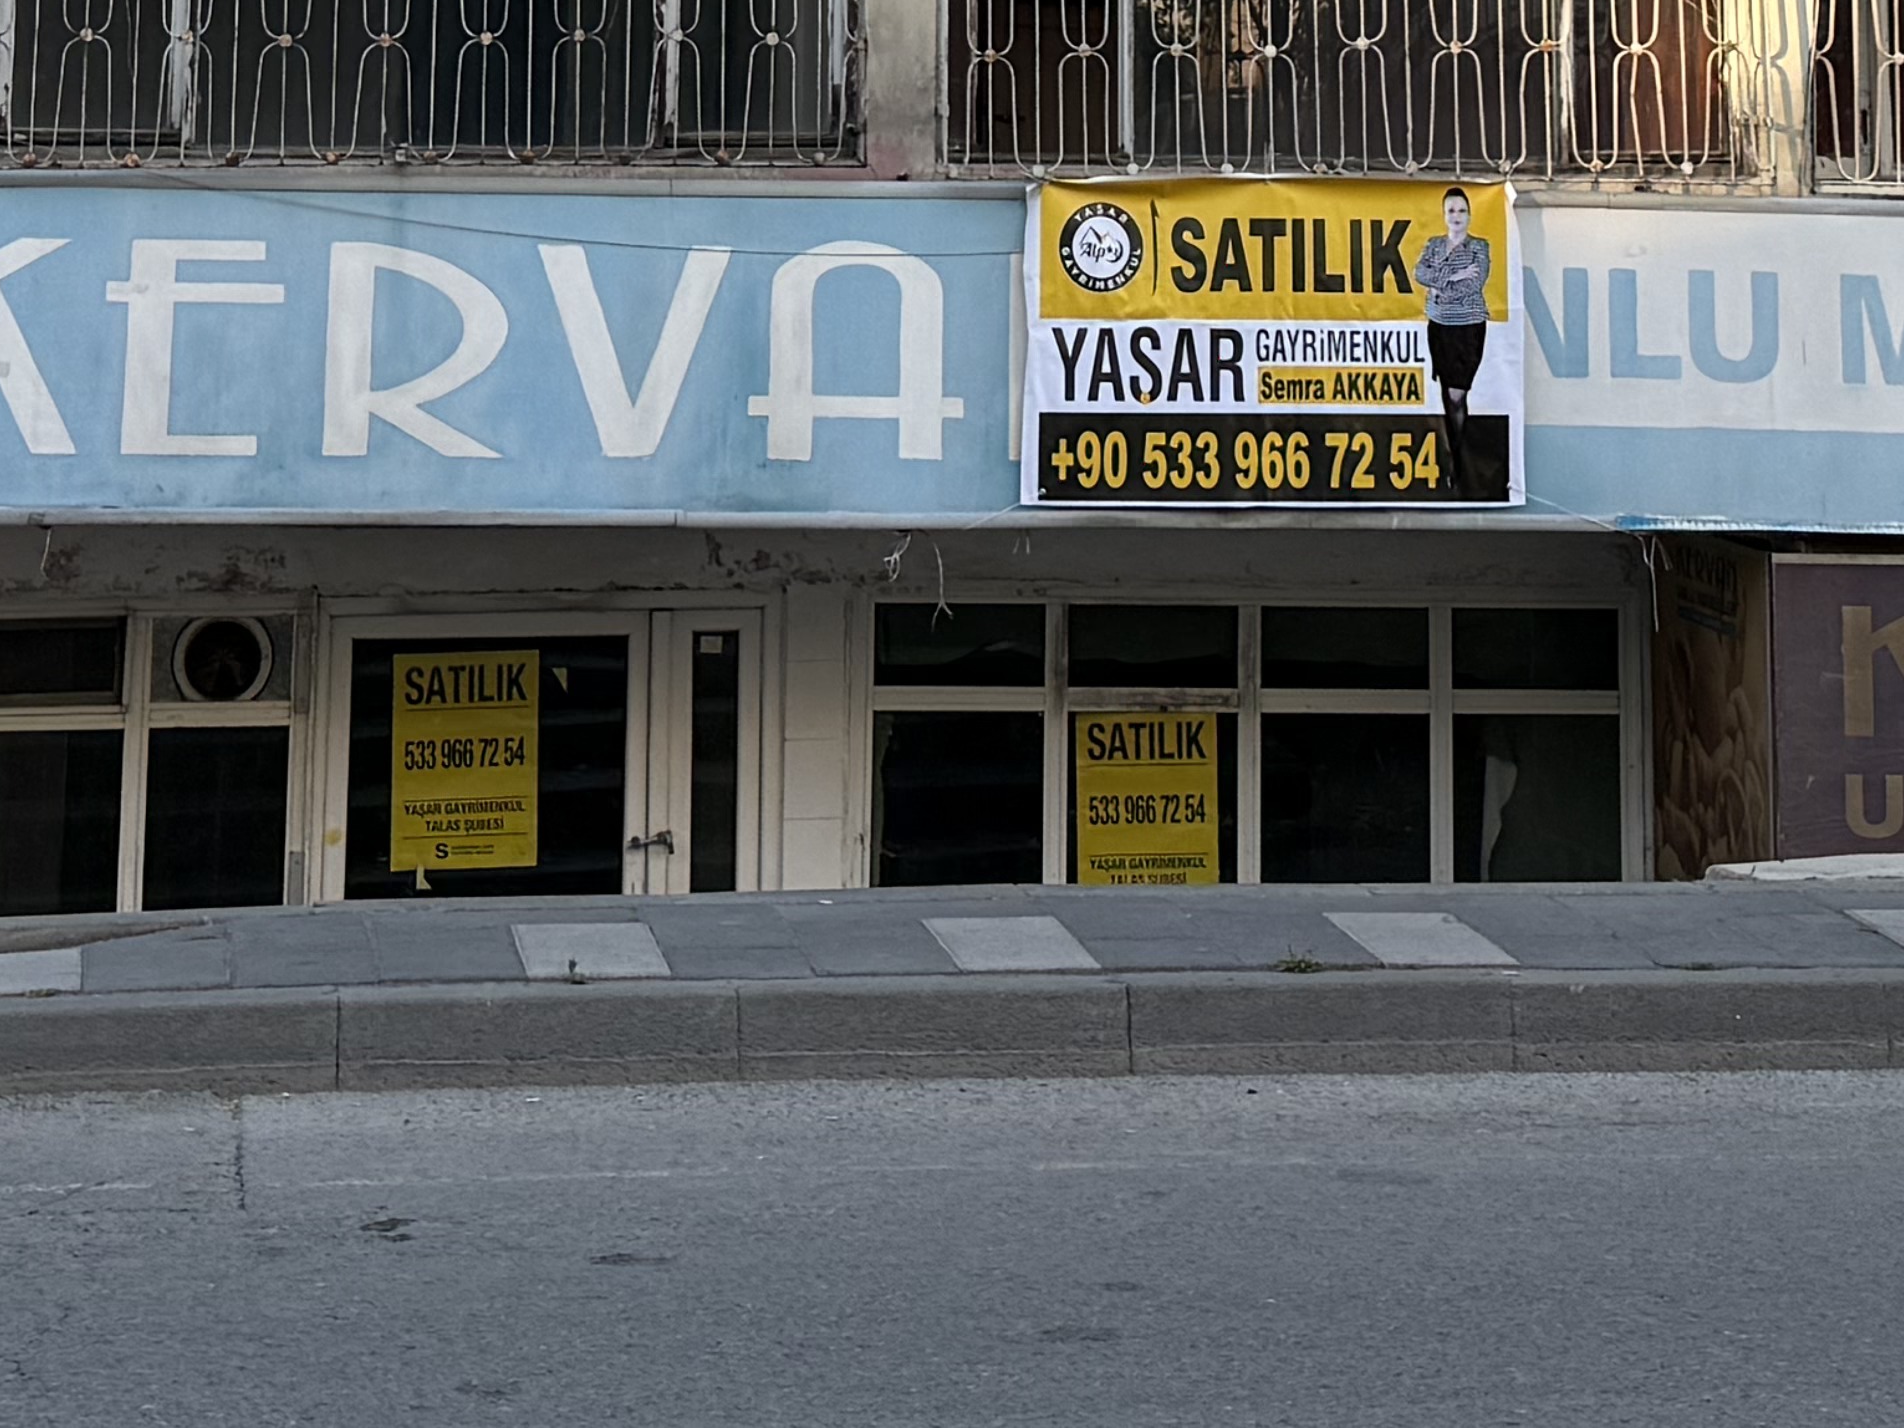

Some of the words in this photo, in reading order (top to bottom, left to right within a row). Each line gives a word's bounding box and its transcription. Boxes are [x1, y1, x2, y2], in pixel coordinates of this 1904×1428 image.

[1169, 217, 1414, 294] SATILIK
[1260, 371, 1325, 401] Semra
[1331, 371, 1421, 401] AKKAYA
[1051, 431, 1128, 489] +90
[1142, 431, 1220, 490] 533
[1235, 431, 1310, 490] 966
[1325, 432, 1376, 489] 72
[1390, 432, 1440, 489] 54
[404, 662, 528, 706] SATILIK
[404, 739, 437, 771] 533
[441, 737, 474, 769] 966
[478, 737, 499, 768] 72
[503, 735, 526, 767] 54
[1087, 720, 1207, 761] SATILIK
[425, 819, 462, 833] TALAS
[1088, 795, 1121, 826] 533
[1124, 794, 1157, 825] 966
[1160, 794, 1182, 824] 72
[1185, 793, 1206, 824] 54
